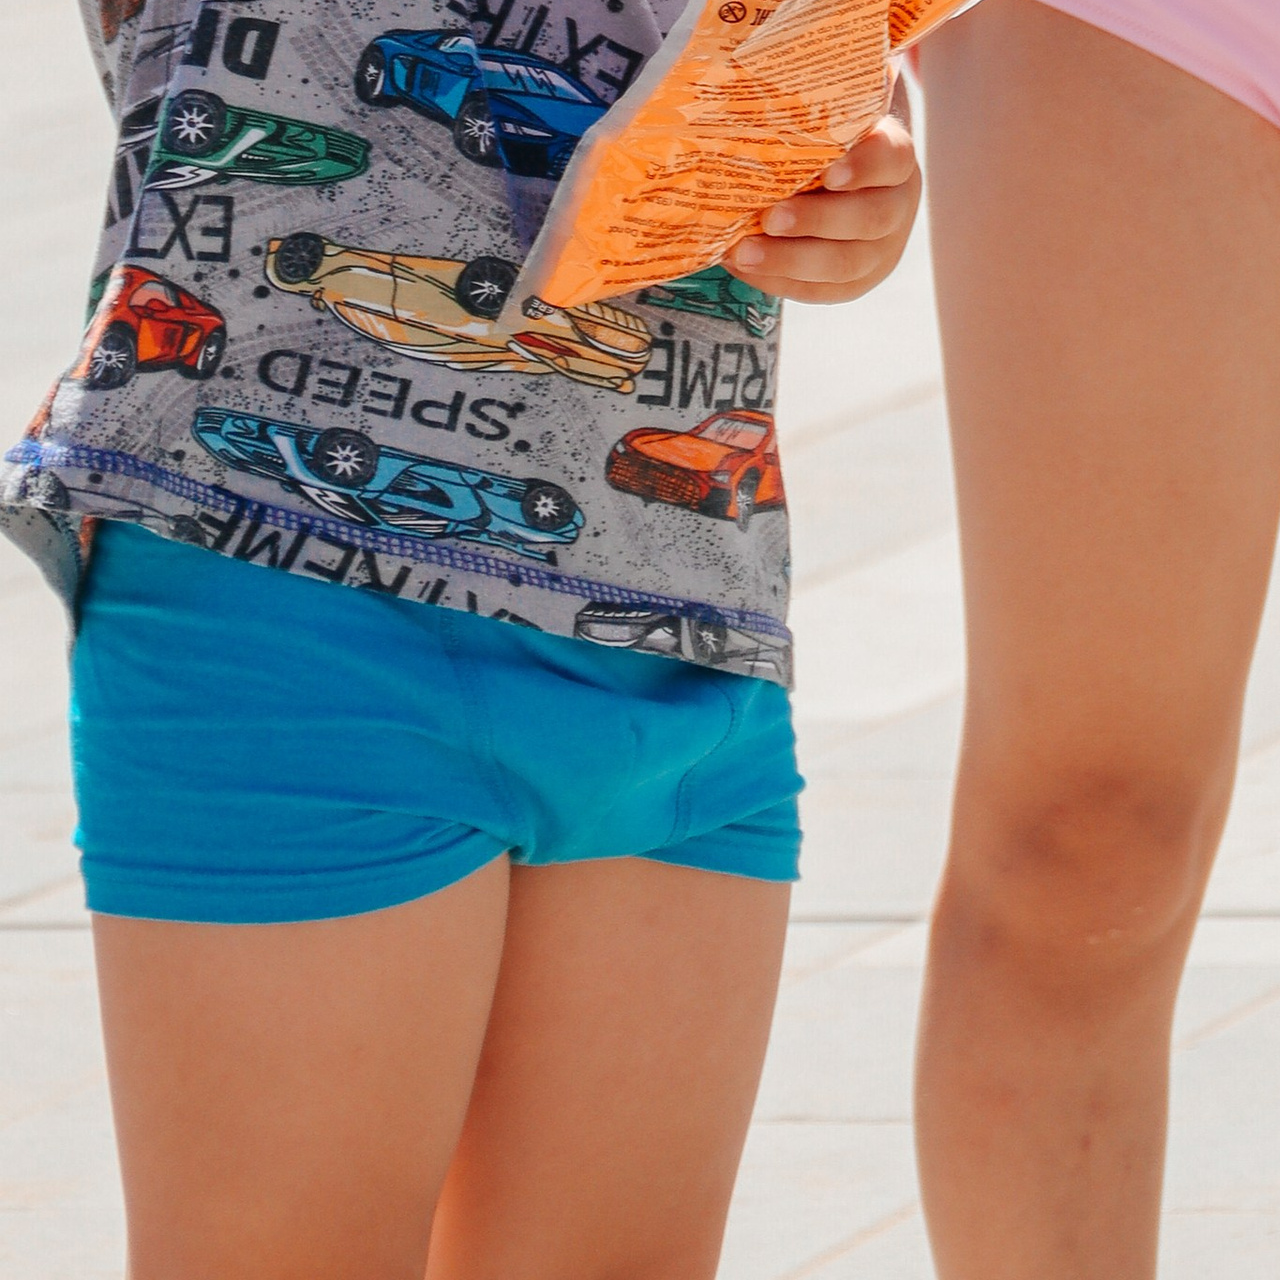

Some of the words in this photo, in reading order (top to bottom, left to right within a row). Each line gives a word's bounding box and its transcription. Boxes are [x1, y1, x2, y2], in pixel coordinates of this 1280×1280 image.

[126, 191, 235, 263] EXT
[530, 298, 555, 315] ERE
[257, 350, 511, 442] SPEED
[637, 340, 773, 409] REME
